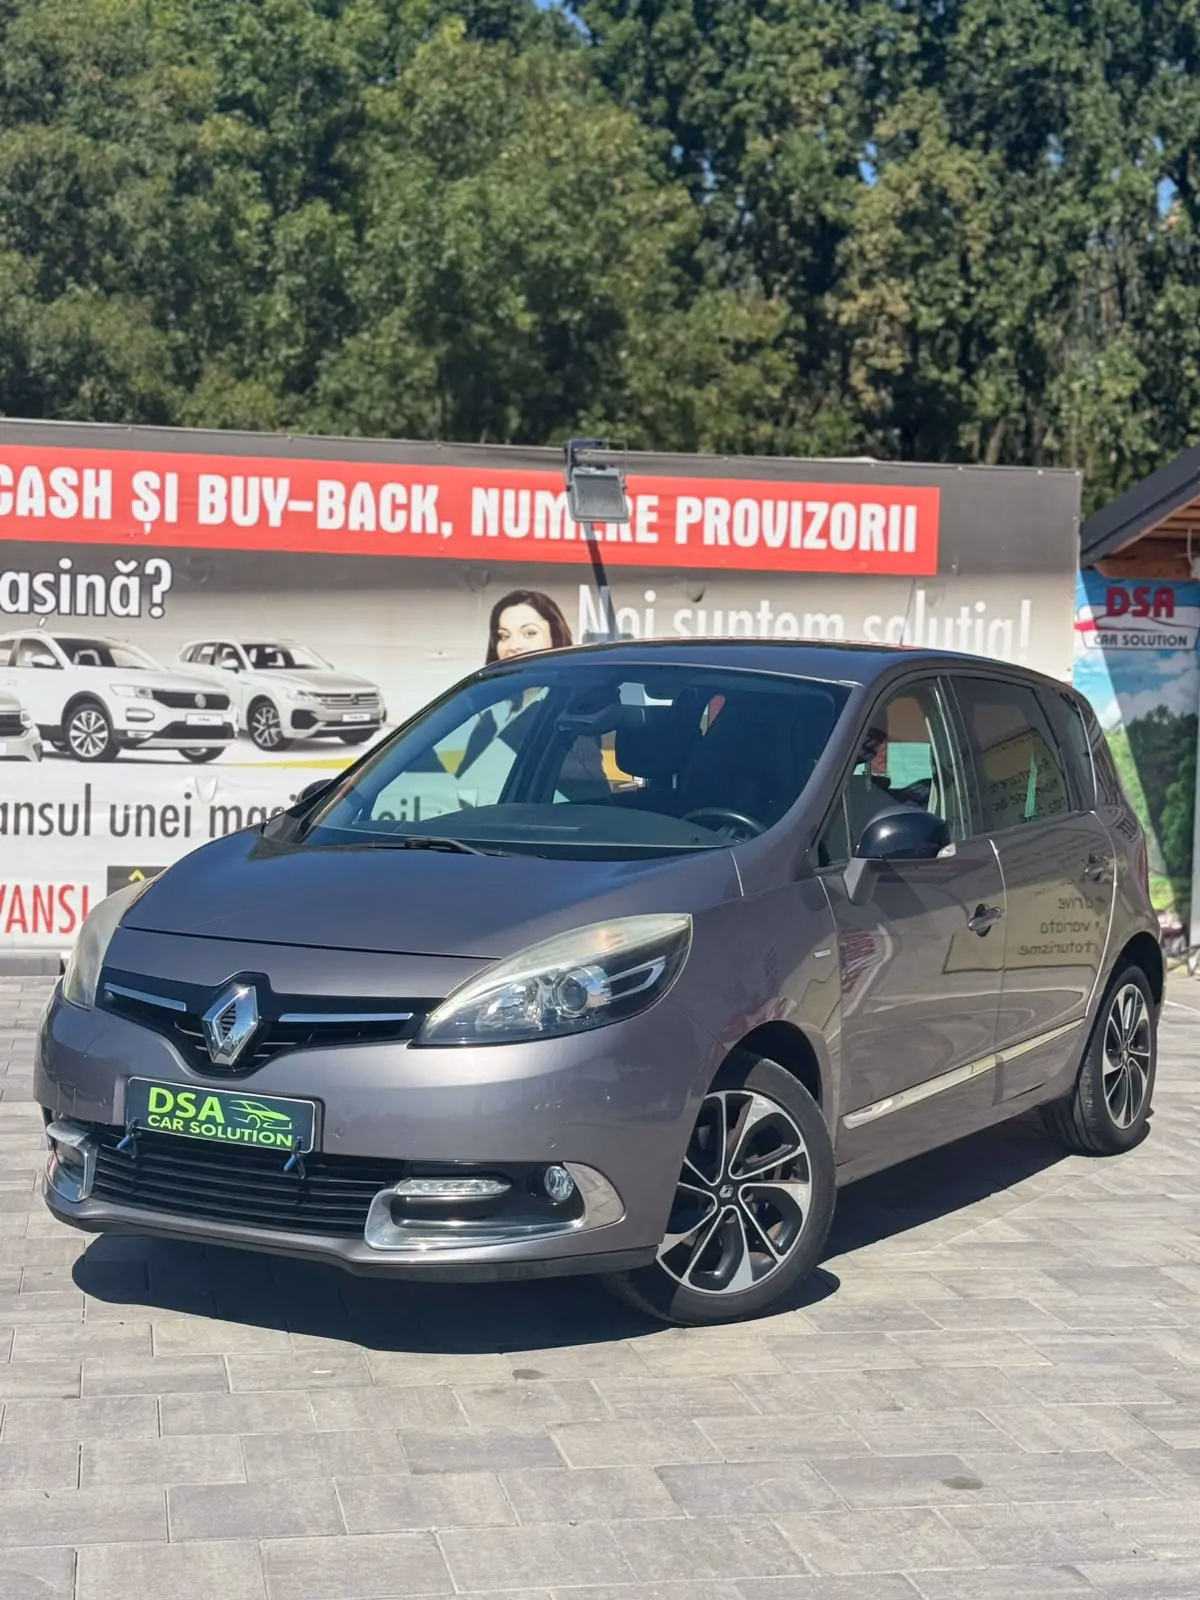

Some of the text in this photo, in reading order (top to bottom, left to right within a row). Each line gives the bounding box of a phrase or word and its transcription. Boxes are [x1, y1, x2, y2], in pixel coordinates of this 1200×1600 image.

[131, 470, 179, 535] ȘI
[675, 496, 917, 552] PROVIZORII
[1106, 585, 1175, 618] DSA
[1094, 634, 1188, 646] CAR SOLUTION
[109, 792, 192, 838] unei
[148, 1087, 225, 1124] DSA
[147, 1115, 293, 1147] CAR SOLUTION
